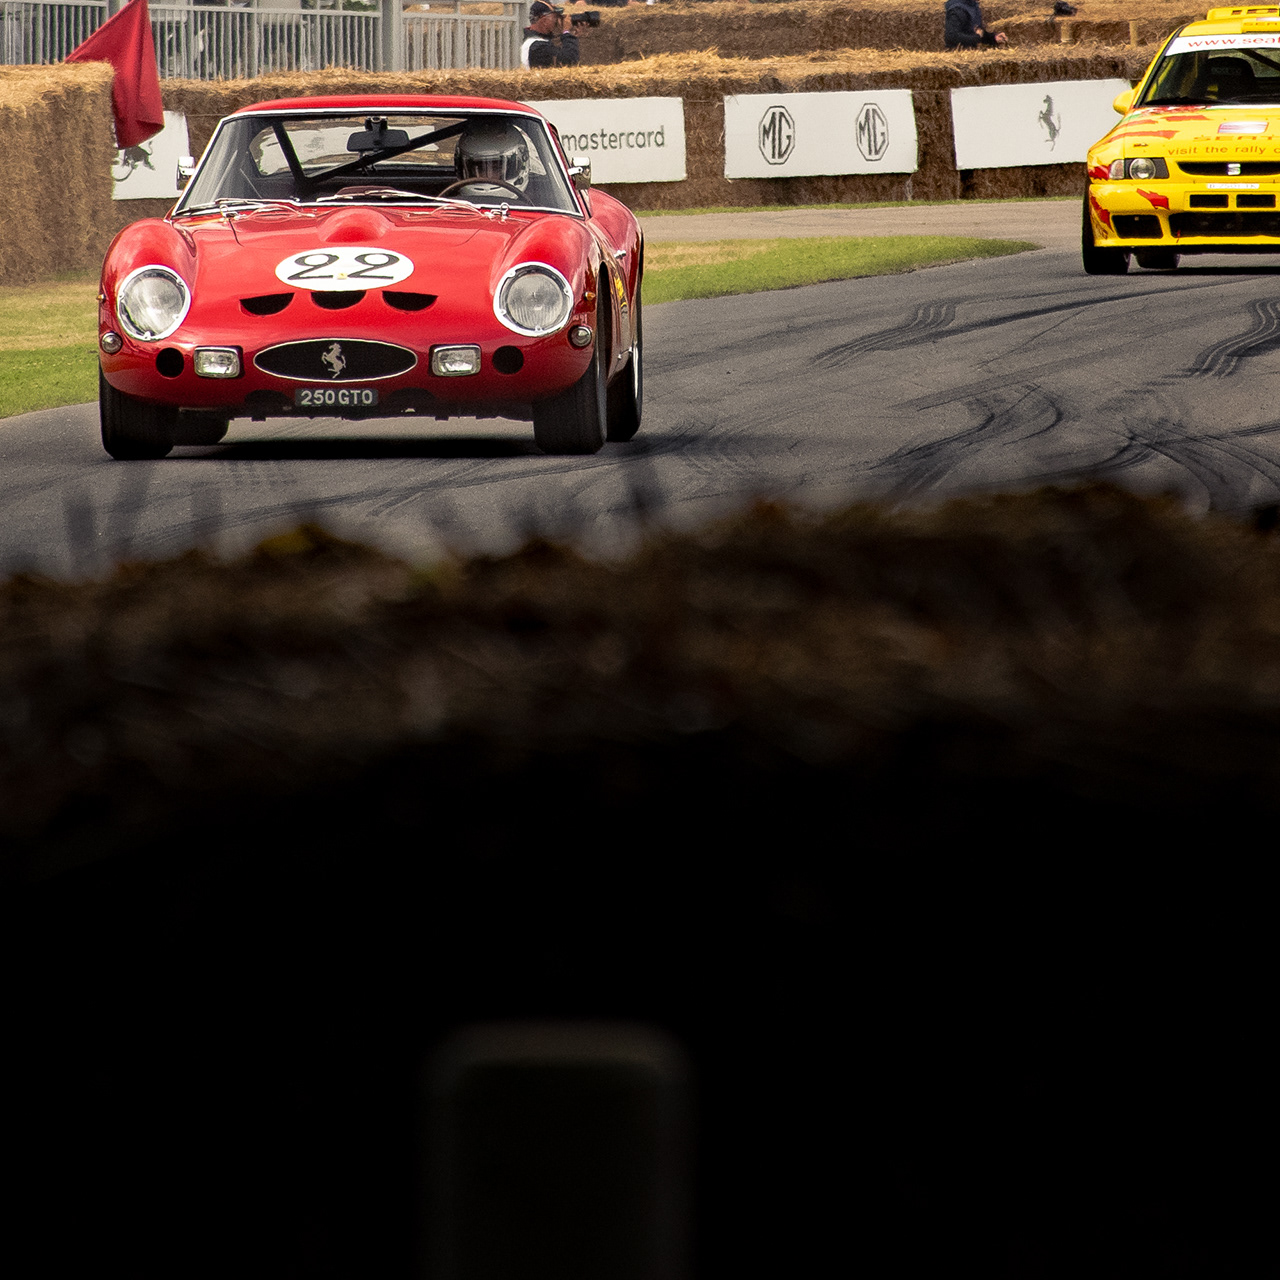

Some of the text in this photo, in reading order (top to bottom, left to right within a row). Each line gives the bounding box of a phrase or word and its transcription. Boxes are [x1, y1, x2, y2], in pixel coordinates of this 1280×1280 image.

[561, 125, 665, 151] mastercard
[762, 111, 792, 160] MG
[859, 108, 886, 157] MG
[1167, 146, 1198, 156] visit
[1205, 145, 1228, 154] the
[1235, 145, 1267, 155] rally
[287, 253, 400, 280] 22
